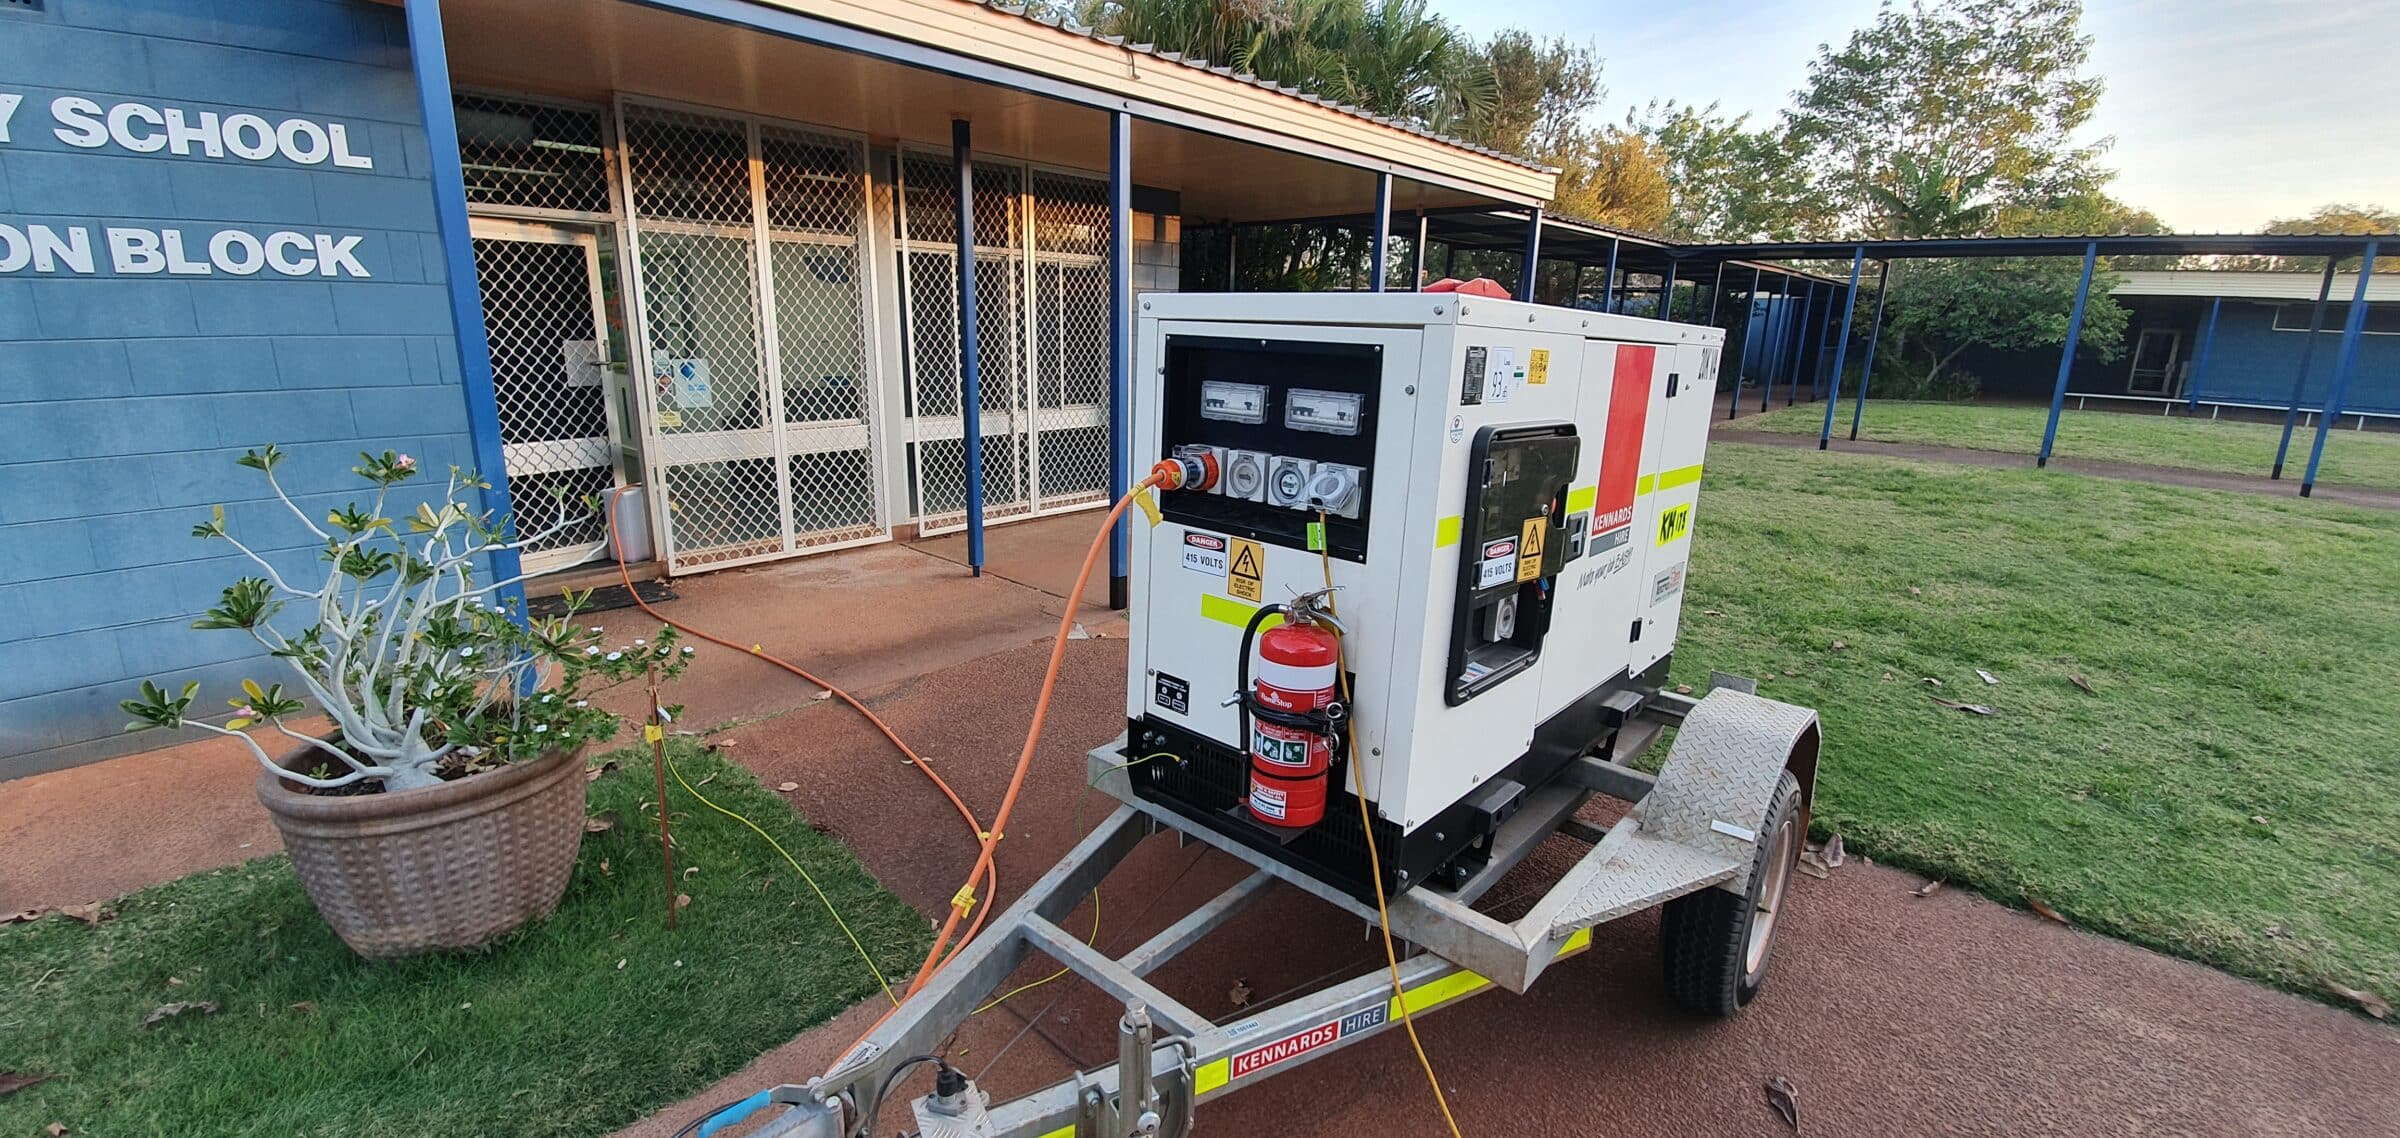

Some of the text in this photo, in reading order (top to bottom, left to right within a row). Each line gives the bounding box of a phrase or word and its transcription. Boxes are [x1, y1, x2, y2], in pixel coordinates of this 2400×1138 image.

[50, 96, 373, 169] SCHOOL
[0, 223, 372, 278] ON BLOCK
[1491, 371, 1503, 398] 93
[1593, 505, 1633, 533] KENNARDS
[1191, 536, 1218, 547] DANGER
[1614, 529, 1630, 547] HIRE
[1185, 552, 1224, 570] 415 VOLTS
[1483, 562, 1513, 578] 415 VOLTS
[1238, 1008, 1381, 1073] KENNARDS HIRE
